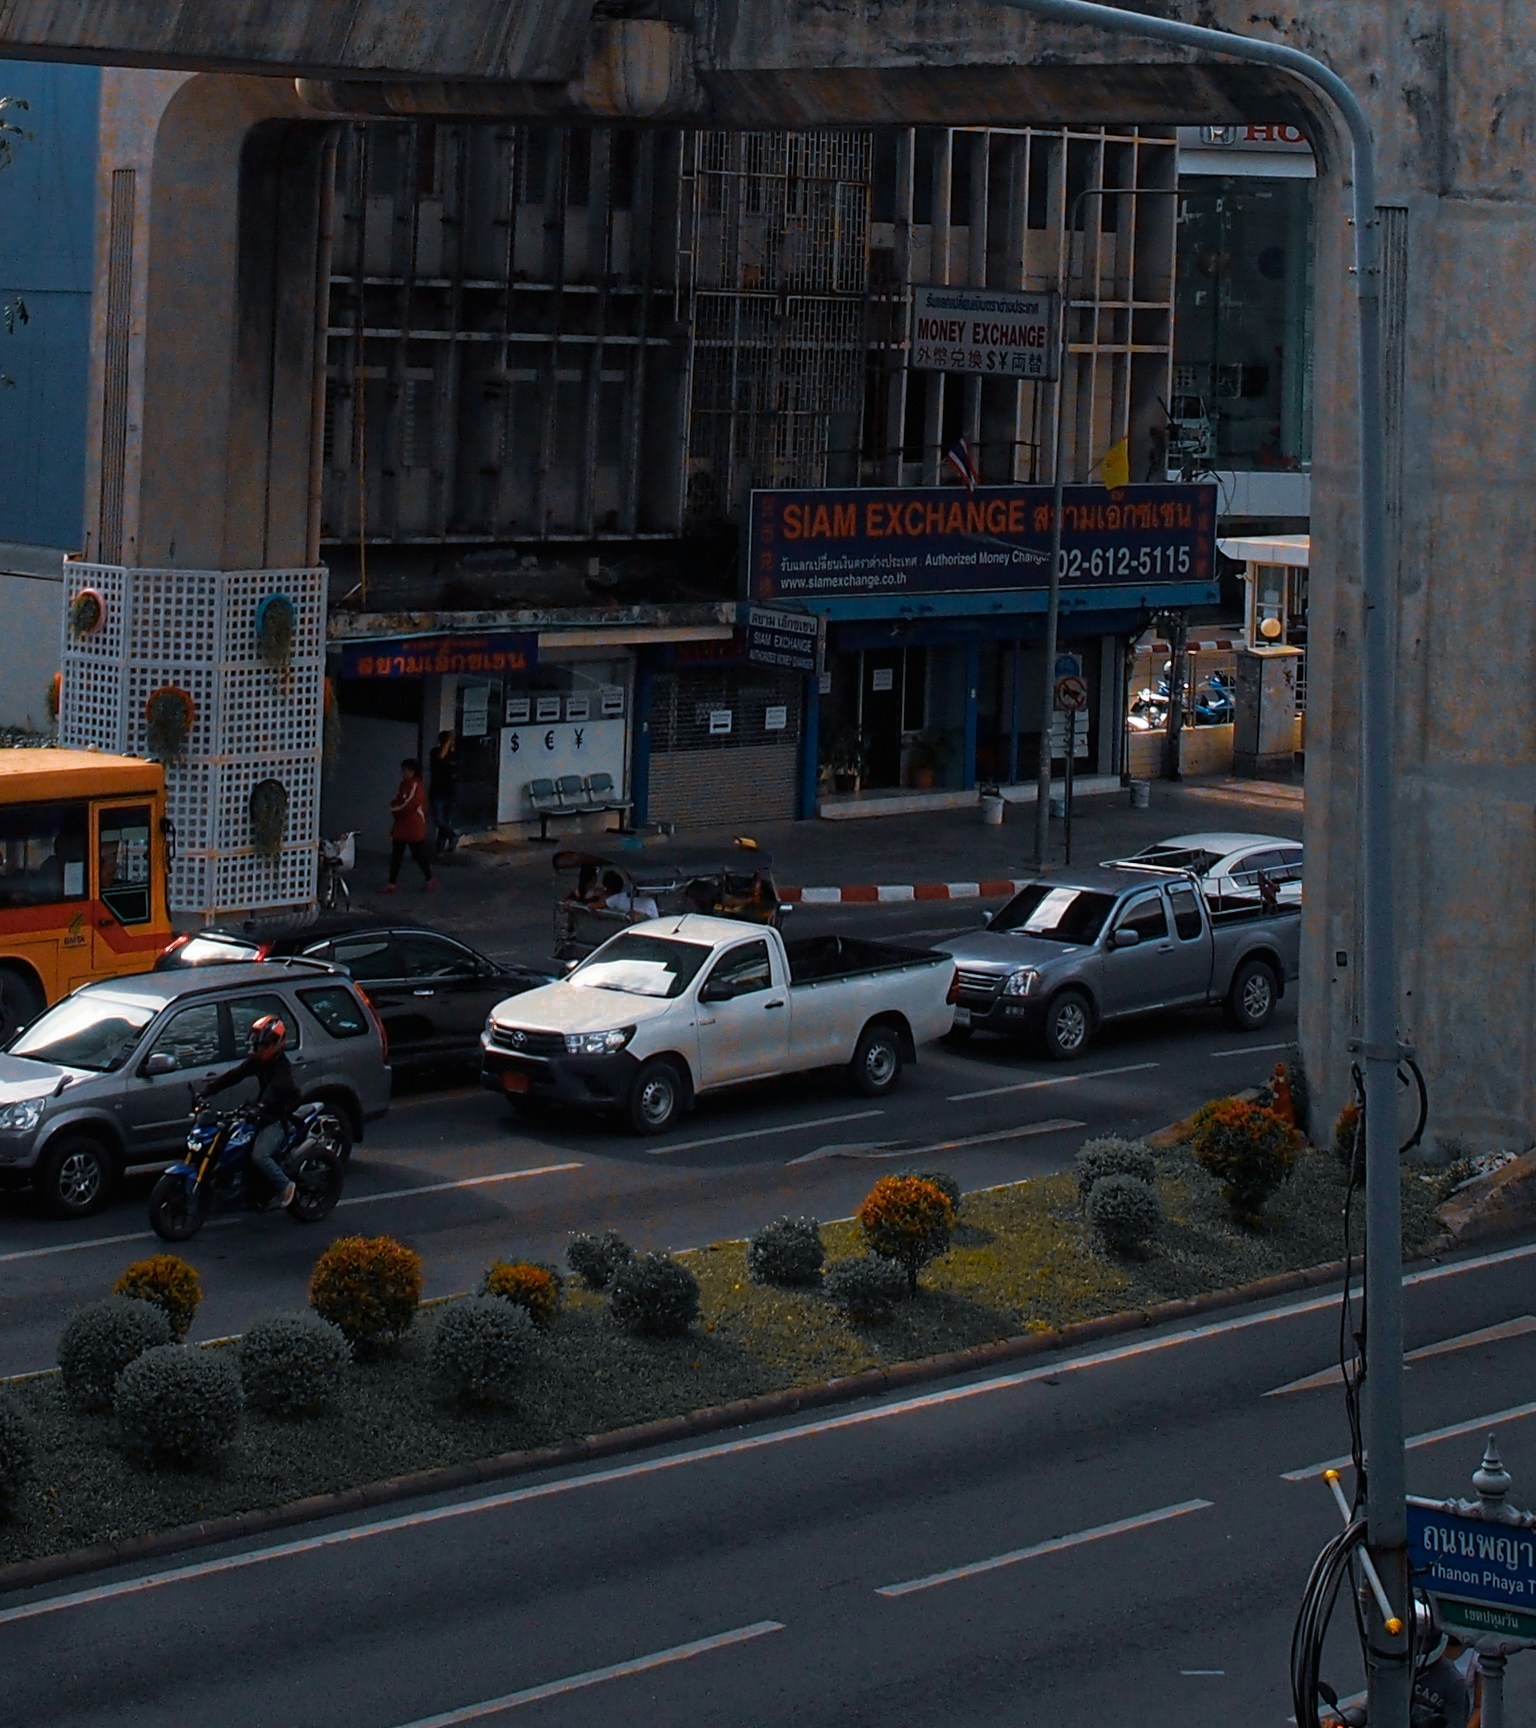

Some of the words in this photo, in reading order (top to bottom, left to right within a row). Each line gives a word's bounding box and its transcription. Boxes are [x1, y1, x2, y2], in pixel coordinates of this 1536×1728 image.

[918, 318, 966, 343] MONEY
[972, 322, 1046, 349] EXCHANGE
[783, 502, 858, 540] SIAM
[866, 498, 1026, 538] EXCHANGE
[1033, 490, 1191, 532] สามเอ็กซเชน
[925, 553, 977, 567] Authorized
[979, 551, 1010, 567] Money
[1059, 546, 1191, 579] 02-612-5115
[781, 572, 907, 590] www.siamexchange.co.th
[511, 732, 521, 753] $
[545, 730, 555, 751] €
[574, 728, 585, 749] ¥
[1430, 1560, 1480, 1586] Thanon
[1482, 1572, 1525, 1597] Phaya
